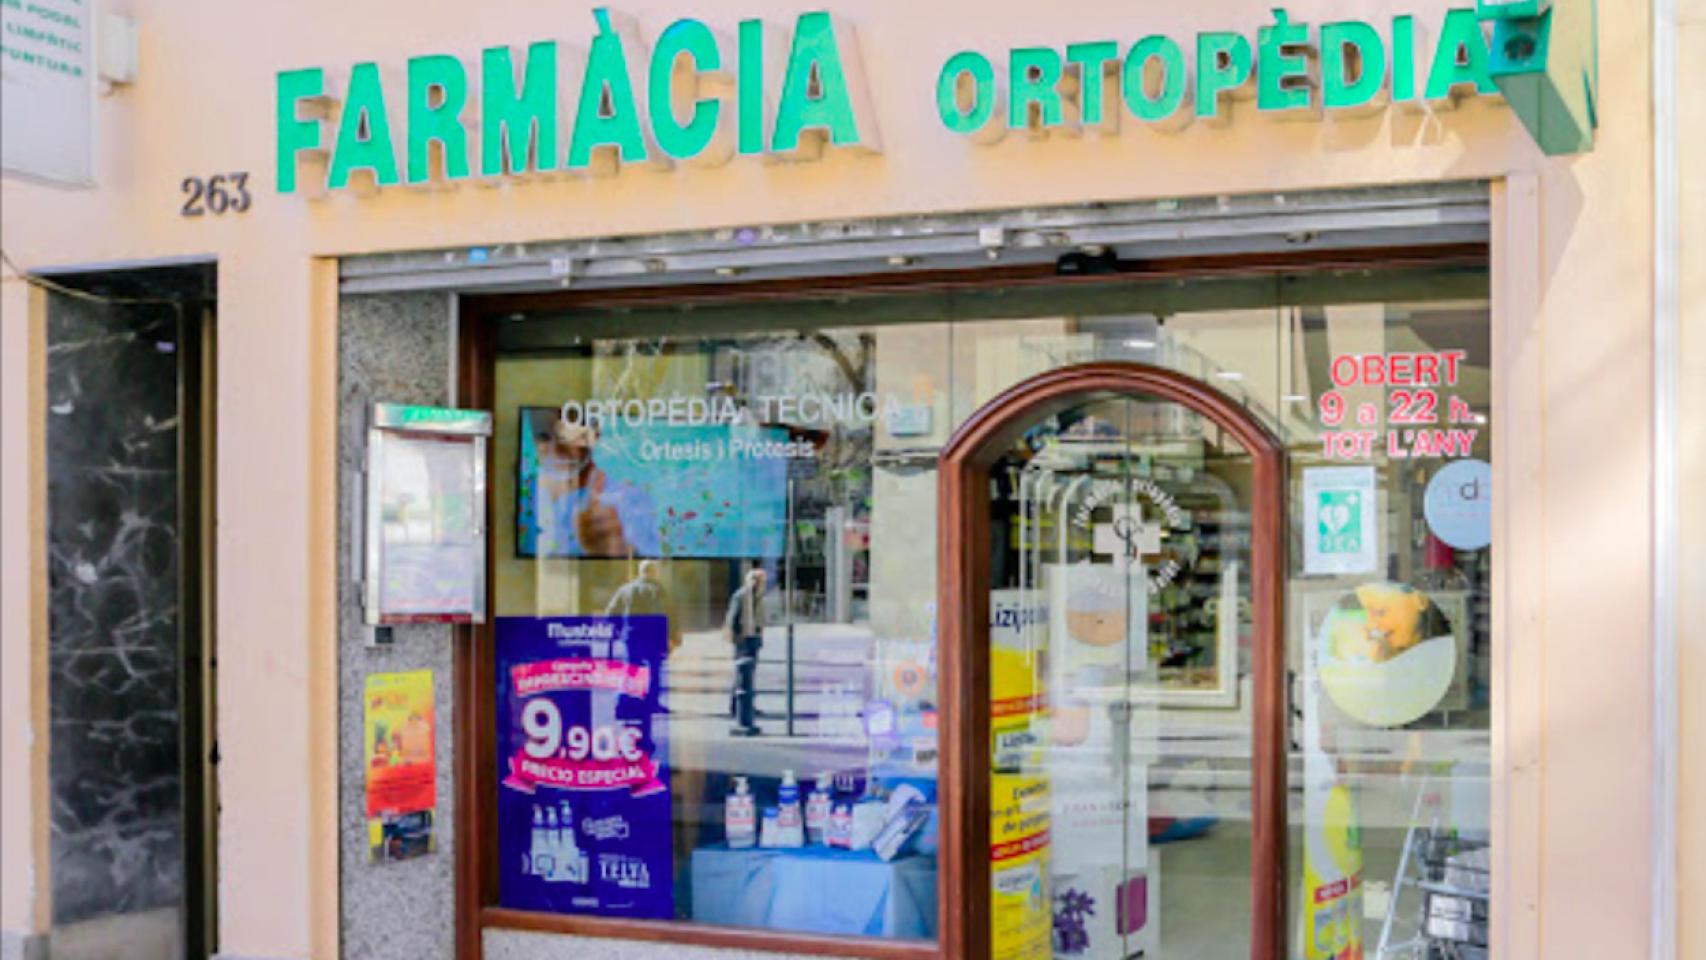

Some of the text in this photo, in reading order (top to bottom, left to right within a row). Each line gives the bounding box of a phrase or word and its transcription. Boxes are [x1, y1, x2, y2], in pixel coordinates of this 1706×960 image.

[276, 8, 1497, 193] FARMÀCIA ORTOPÈDIA
[180, 172, 251, 217] 263
[1331, 351, 1466, 387] OBERT
[1319, 389, 1346, 426] 9
[1356, 402, 1377, 425] a
[1388, 388, 1438, 424] 22
[1319, 429, 1478, 460] TOT L'ANY
[521, 760, 647, 785] PRECIO ESPECIAL
